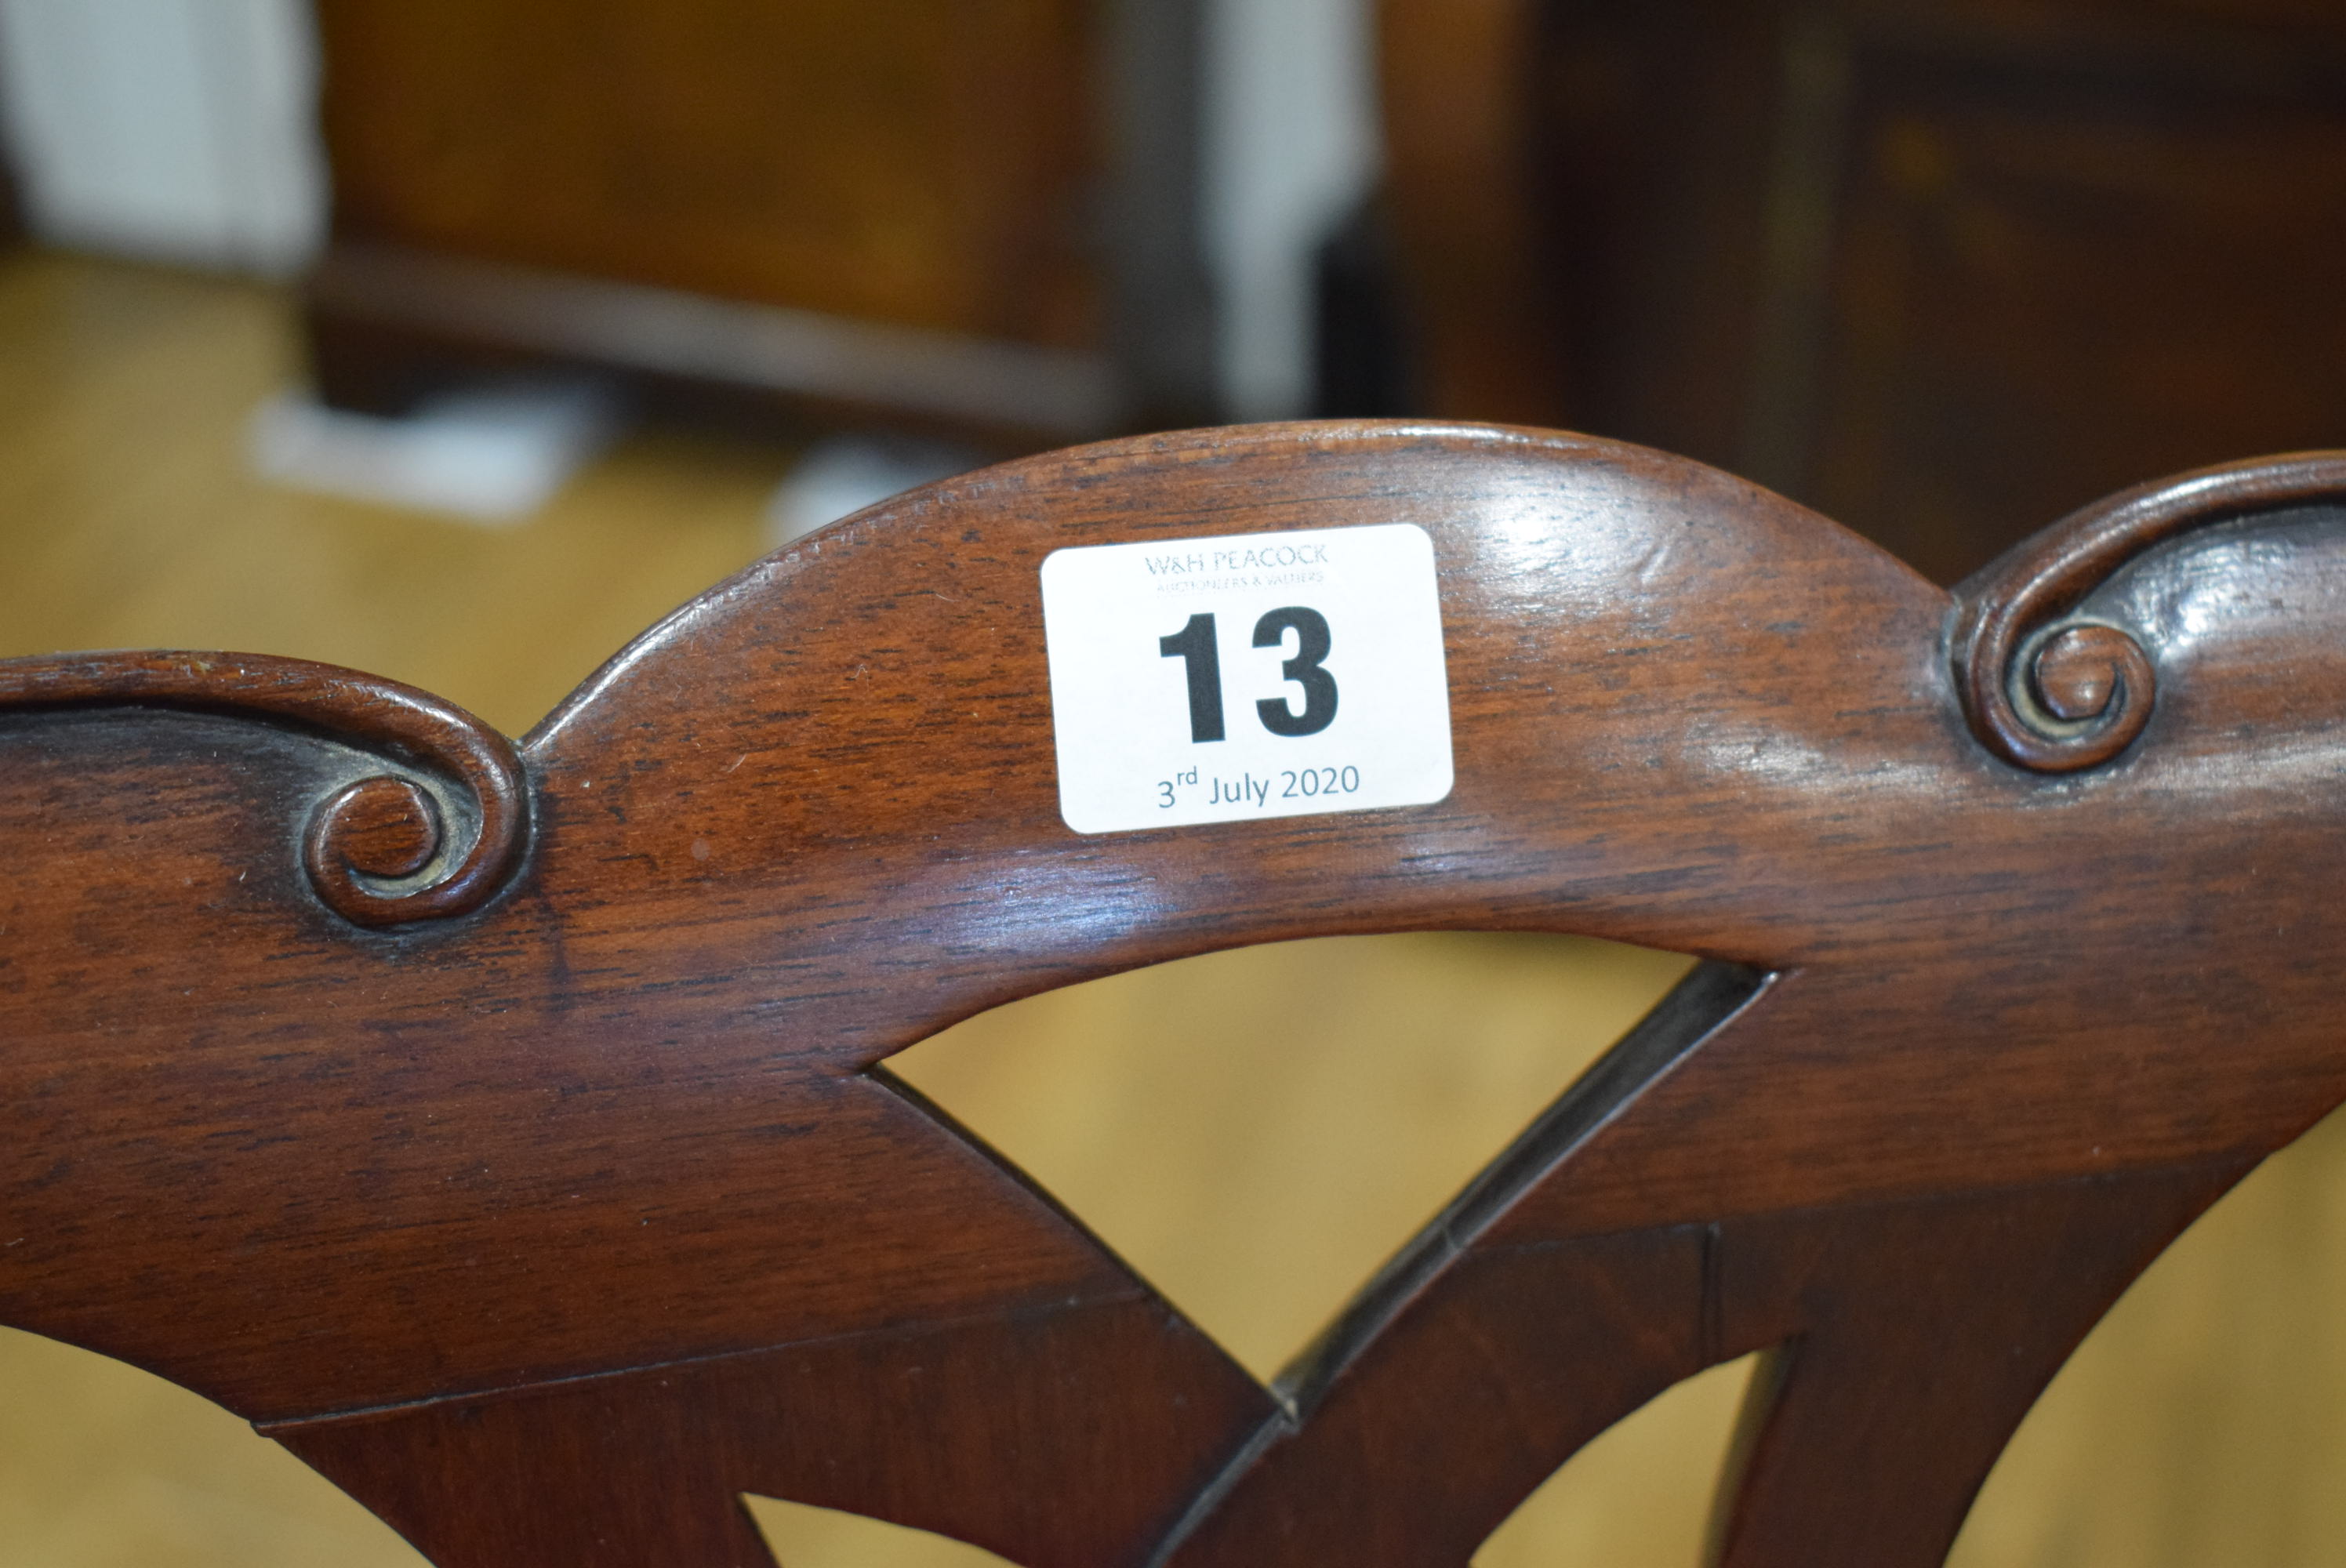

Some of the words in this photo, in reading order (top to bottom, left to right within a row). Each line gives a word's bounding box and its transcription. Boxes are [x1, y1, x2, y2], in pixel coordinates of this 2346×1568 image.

[1145, 554, 1204, 574] W&H
[1215, 545, 1328, 570] PEACOCK
[1159, 606, 1338, 744] 13
[1157, 766, 1198, 808] 3rd
[1209, 773, 1269, 808] July
[1280, 766, 1360, 798] 2020
